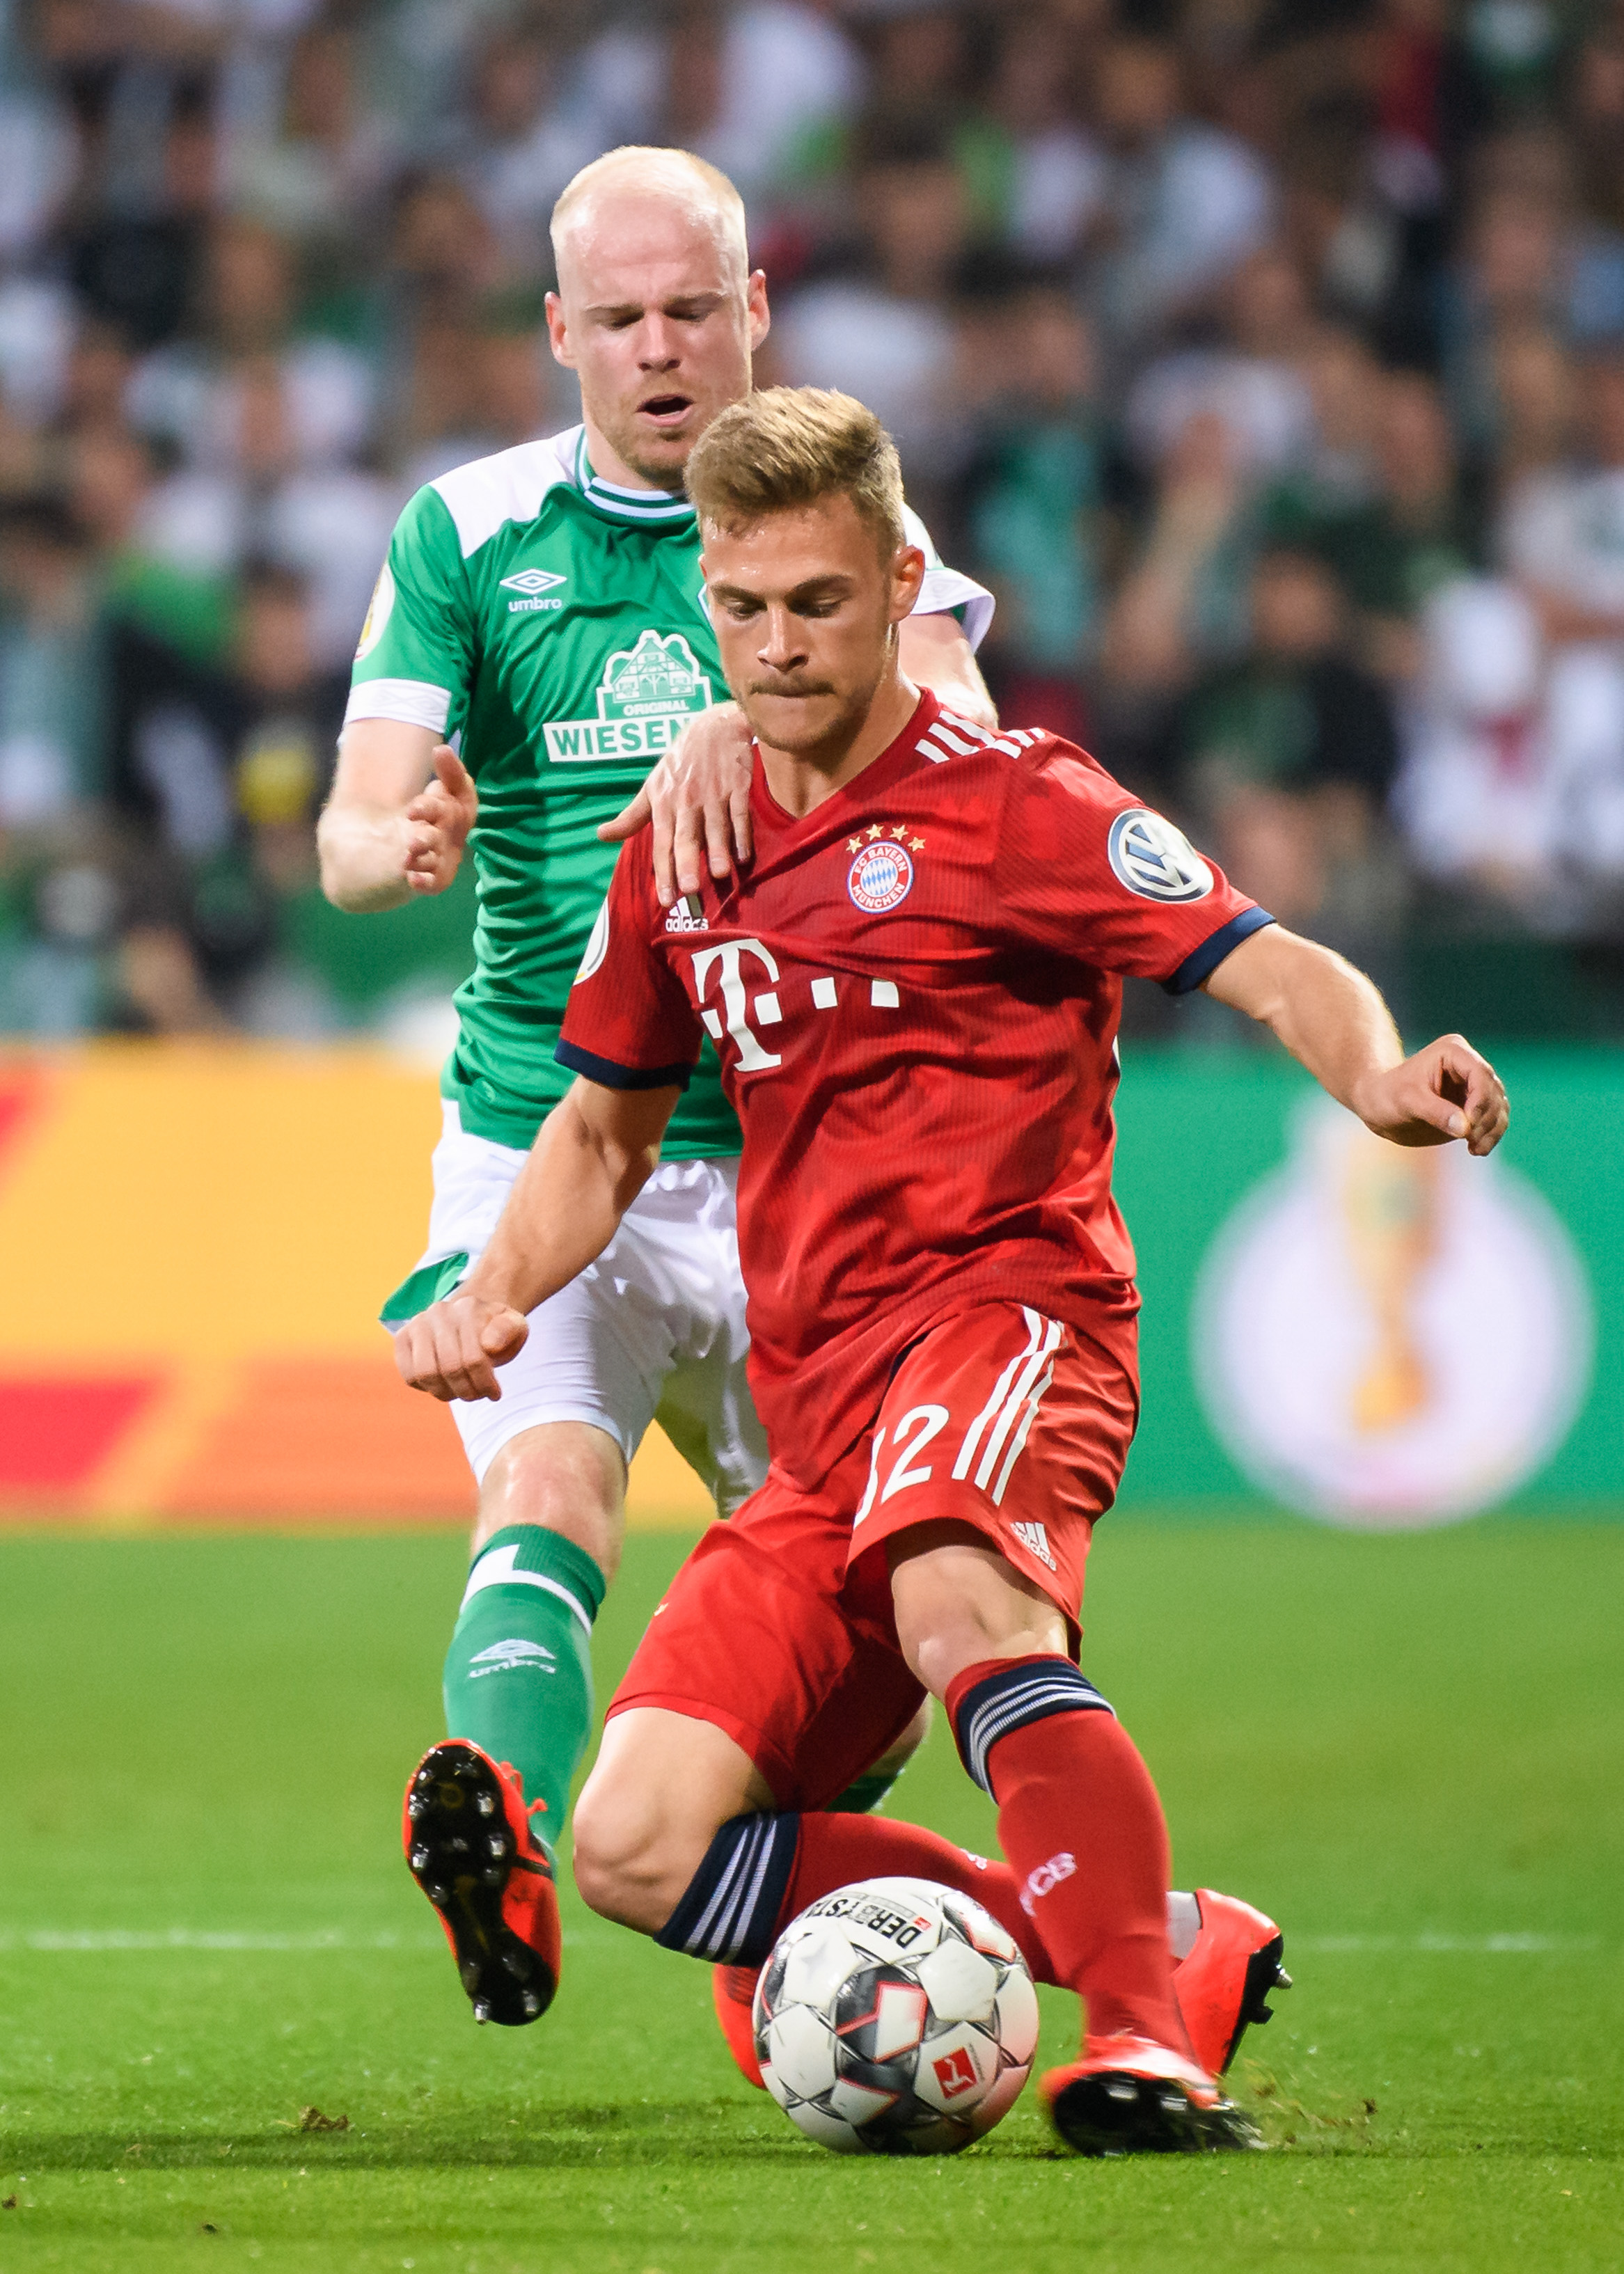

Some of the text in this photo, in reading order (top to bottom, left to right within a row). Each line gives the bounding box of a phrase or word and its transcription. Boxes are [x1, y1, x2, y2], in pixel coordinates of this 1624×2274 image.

[508, 597, 562, 612] umbro
[623, 699, 689, 716] ORIGINAL
[854, 846, 907, 874] FC BAYERN
[665, 915, 709, 932] adidas
[1010, 1524, 1057, 1571] adidas
